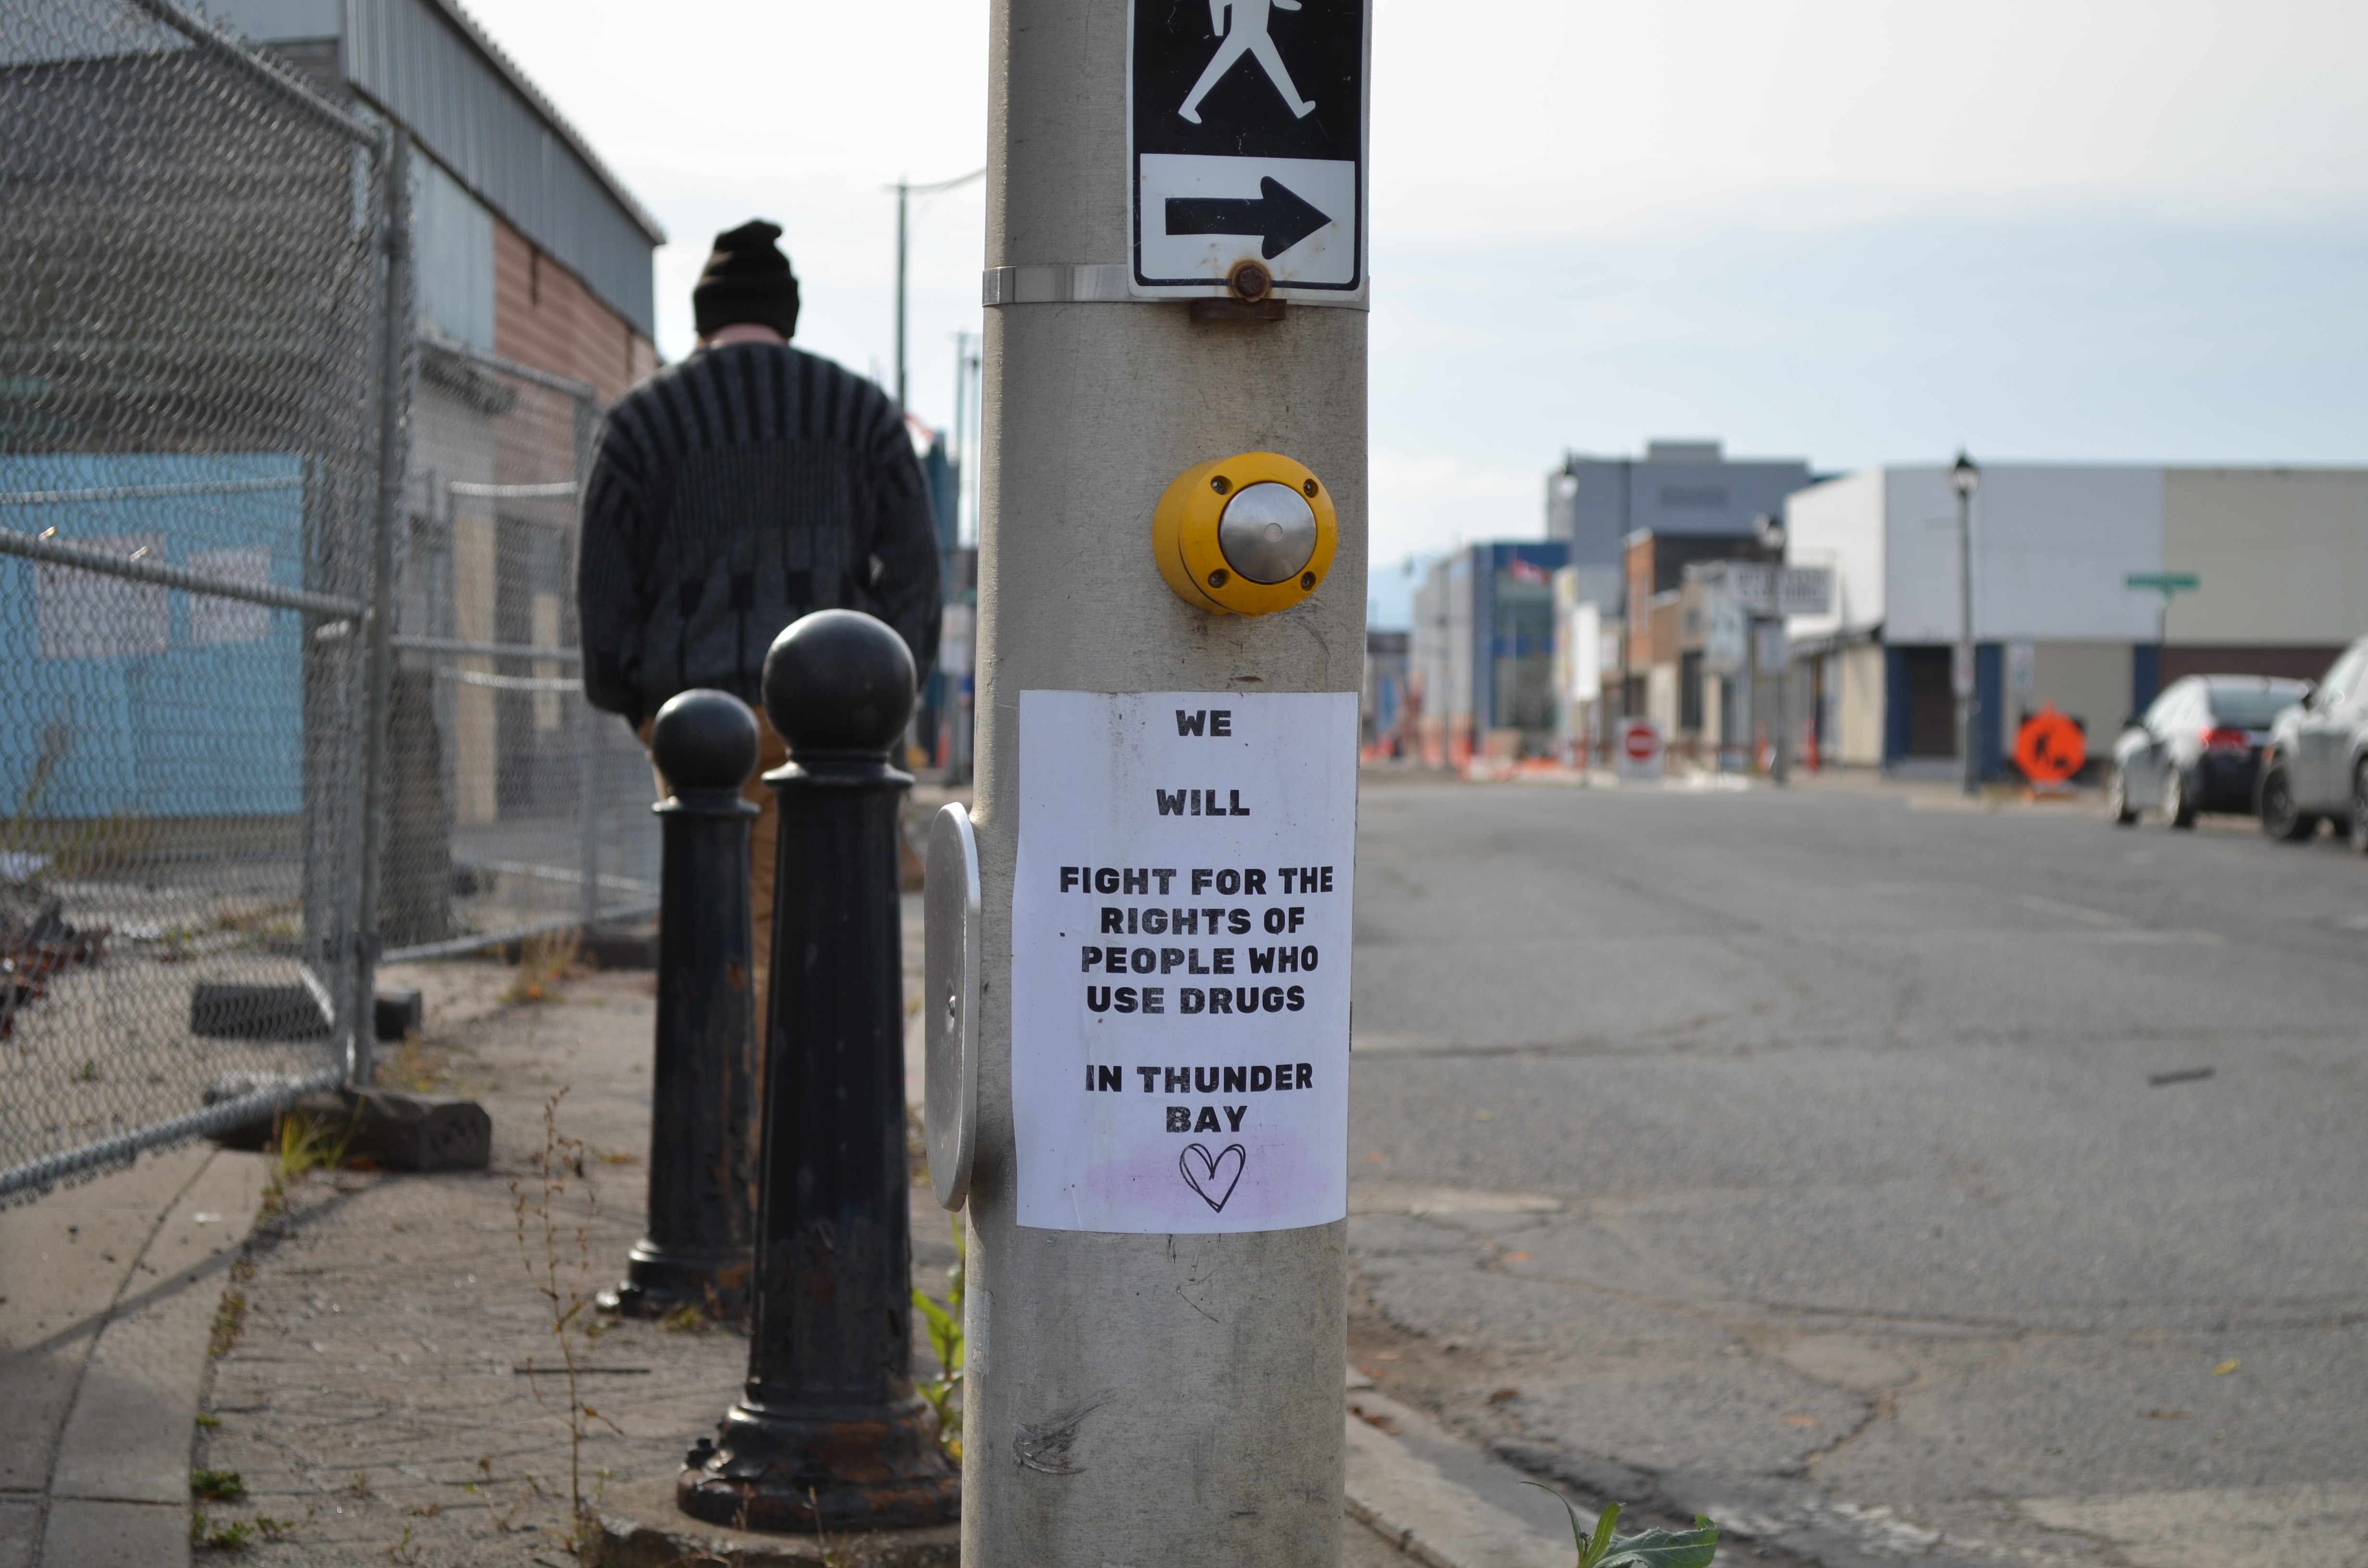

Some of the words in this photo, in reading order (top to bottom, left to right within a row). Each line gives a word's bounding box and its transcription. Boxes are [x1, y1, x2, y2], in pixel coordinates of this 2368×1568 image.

[1176, 710, 1231, 736] WE
[1156, 789, 1250, 816] WILL
[1061, 867, 1176, 894] FIGHT
[1192, 869, 1266, 895] FOR
[1279, 866, 1332, 894] THE
[1101, 907, 1251, 934] RIGHTS
[1264, 907, 1304, 935] OF
[1082, 946, 1234, 974] PEOPLE
[1249, 945, 1318, 973] WHO
[1087, 986, 1164, 1014] USE
[1181, 986, 1305, 1014] DRUGS
[1086, 1065, 1122, 1092] IN
[1137, 1063, 1312, 1093] THUNDER
[1167, 1106, 1247, 1132] BAY
